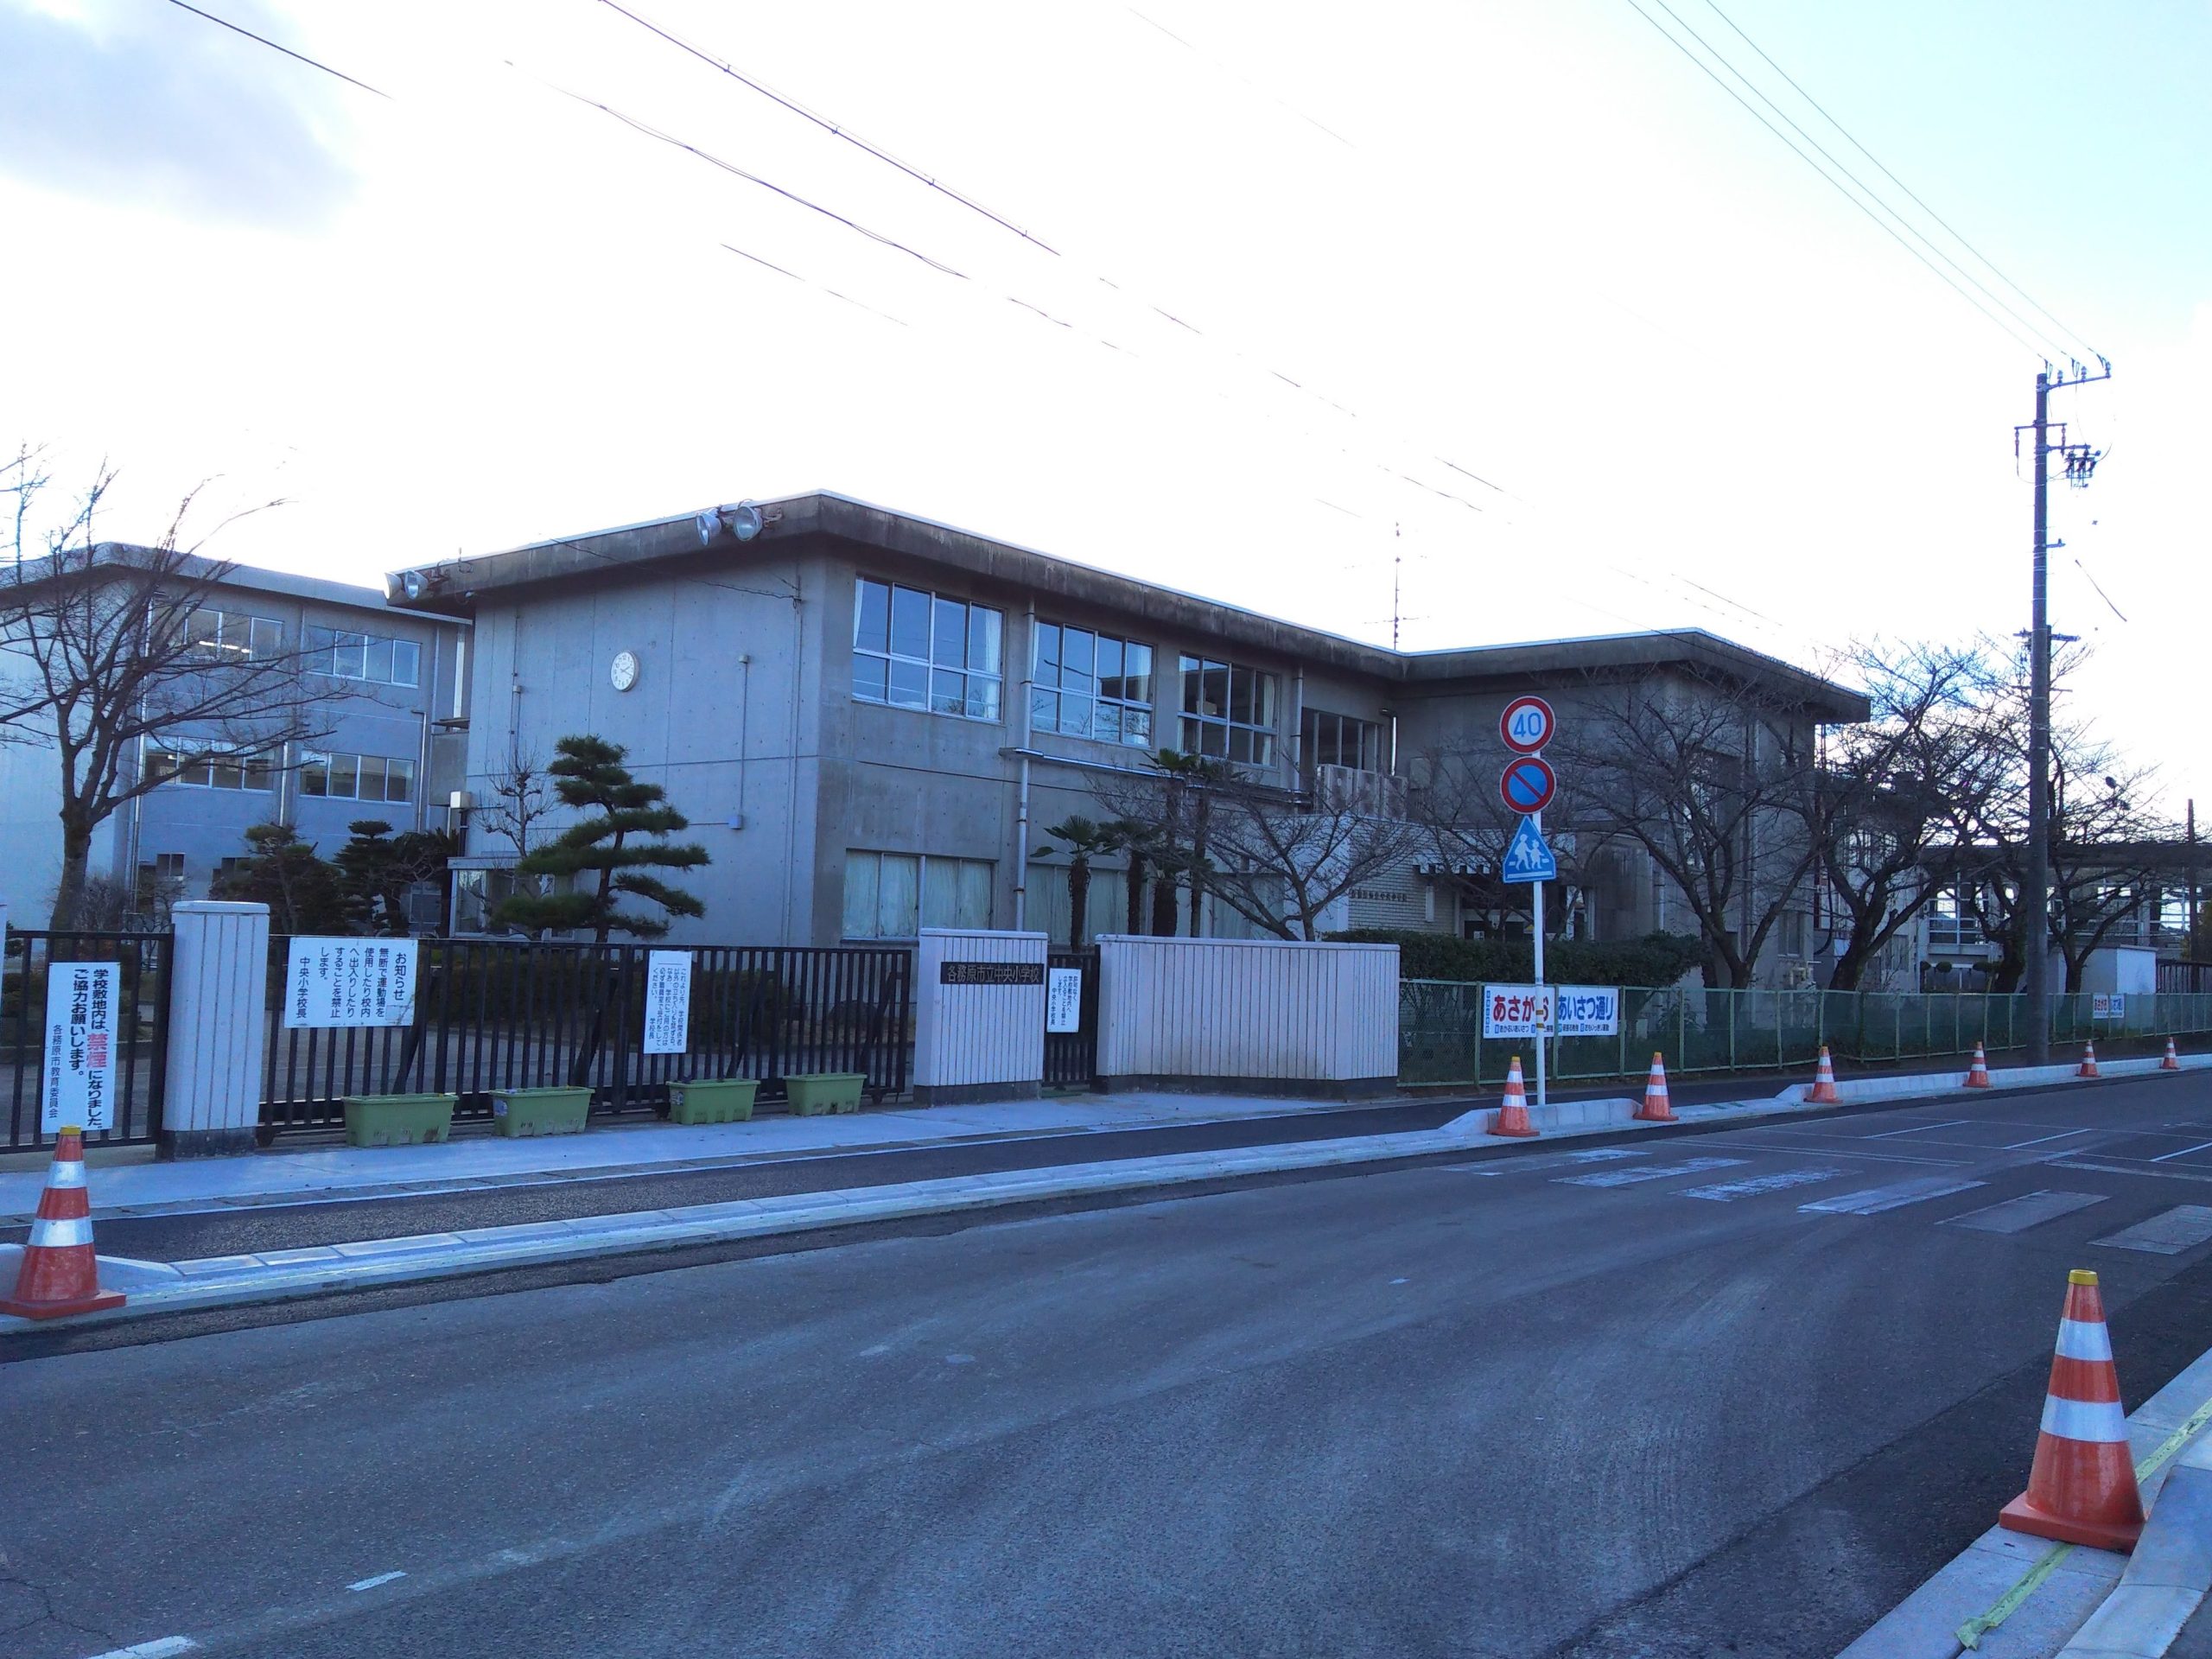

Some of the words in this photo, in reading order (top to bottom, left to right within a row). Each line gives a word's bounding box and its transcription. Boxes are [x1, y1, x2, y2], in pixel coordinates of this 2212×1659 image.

[1513, 712, 1542, 737] 40
[296, 957, 310, 1019] 中央小学校長
[318, 947, 330, 981] します。
[330, 947, 345, 1018] することを禁止
[346, 948, 359, 1018] へ出入りしたり
[360, 947, 375, 1018] 使用したり校内
[375, 948, 389, 1018] 無断で運動場を
[393, 952, 407, 1001] お知らせ
[947, 964, 1039, 983] 各務原市立中央小学校
[68, 969, 89, 1076] ご協力お願いします。
[1558, 995, 1613, 1021] あいさつ通り
[48, 1024, 63, 1118] 各務原市教育委員会
[86, 969, 109, 1128] 学校敷地内は、禁煙になりました。
